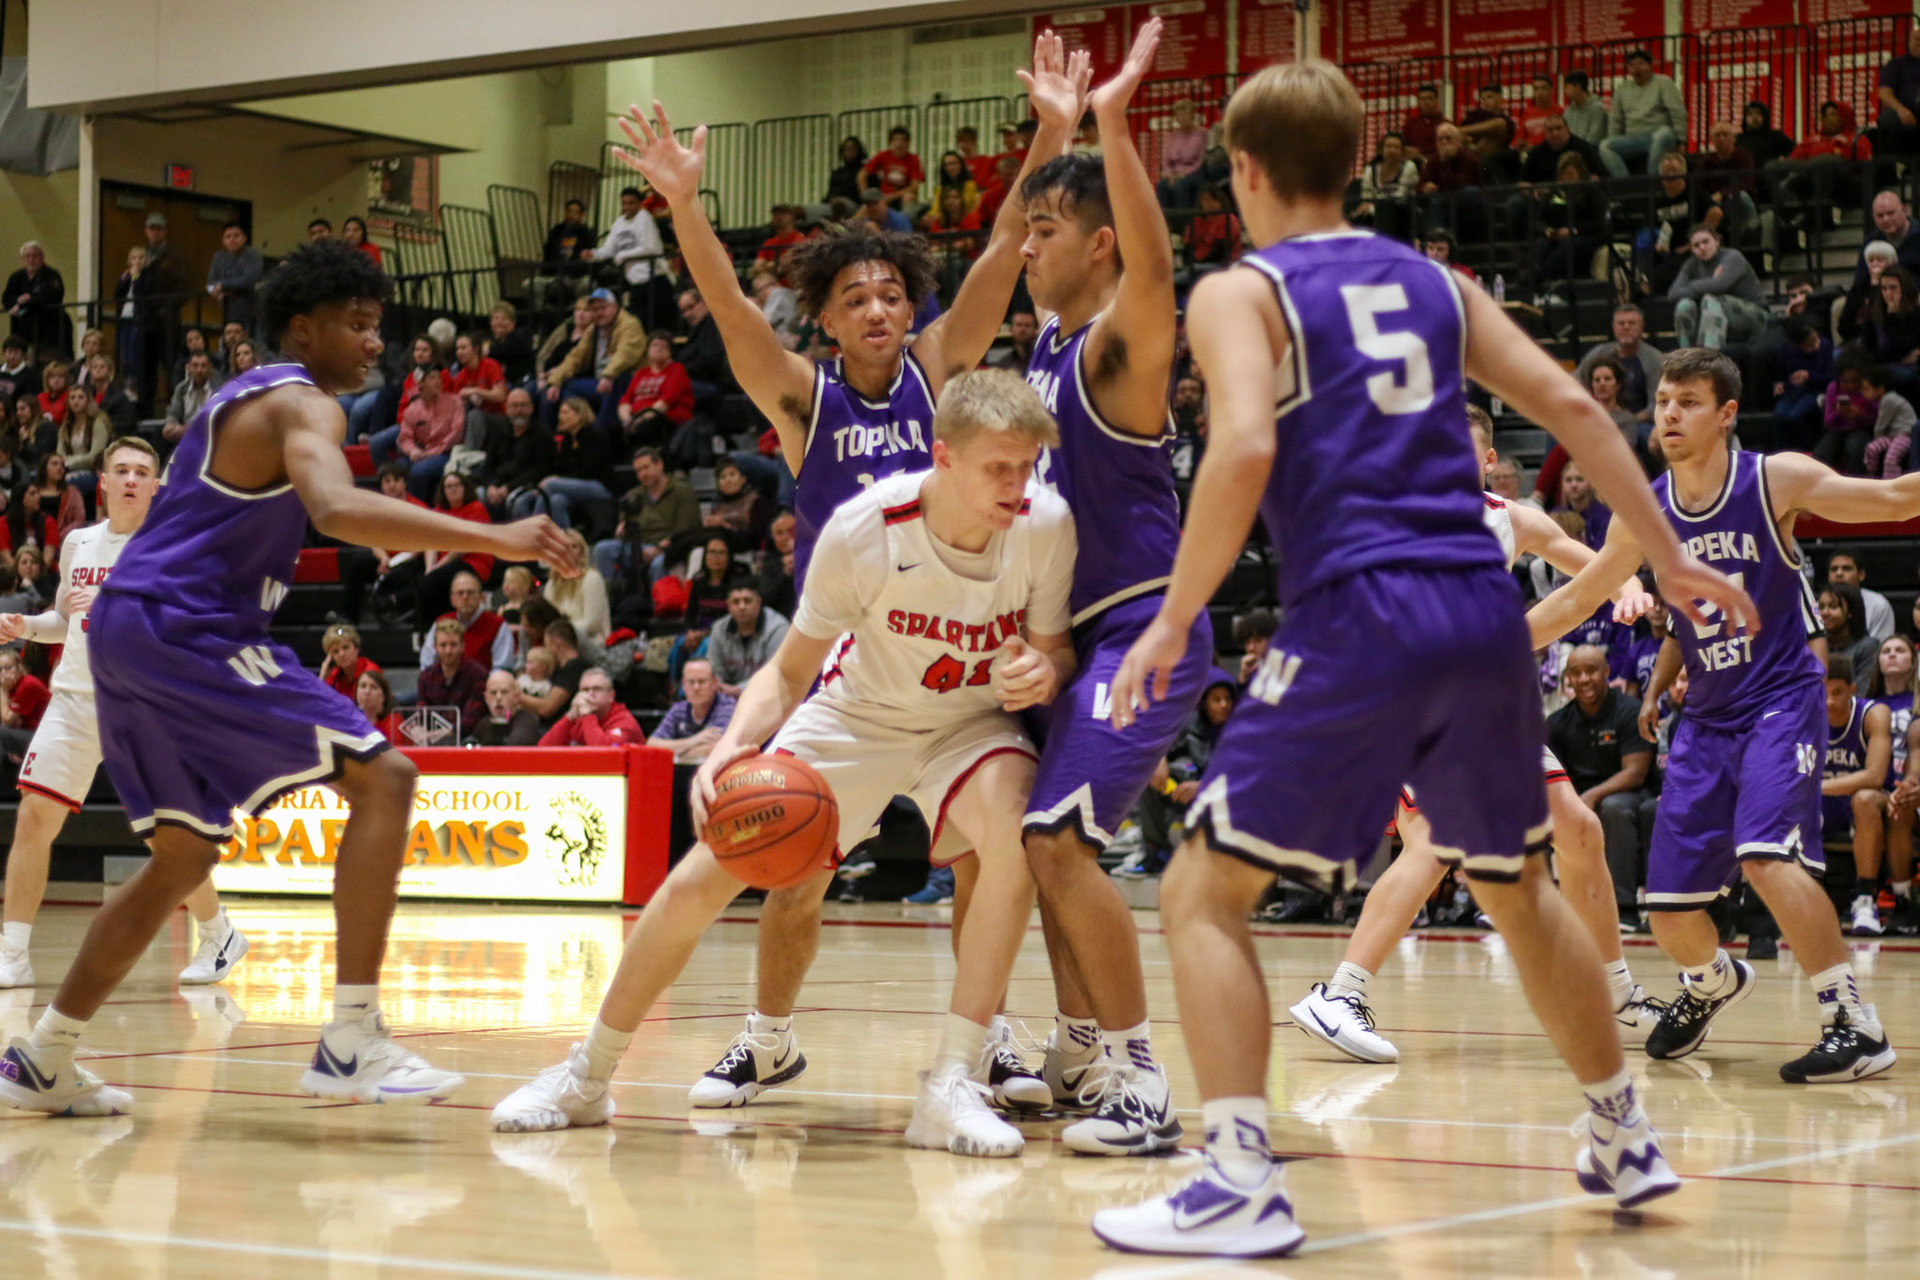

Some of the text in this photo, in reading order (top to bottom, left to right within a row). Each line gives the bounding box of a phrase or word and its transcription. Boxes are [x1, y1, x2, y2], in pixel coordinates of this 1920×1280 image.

[1339, 283, 1435, 415] 5
[833, 419, 930, 463] TOPKA
[227, 645, 284, 686] W
[22, 752, 37, 776] E
[414, 790, 530, 811] SCHOOL
